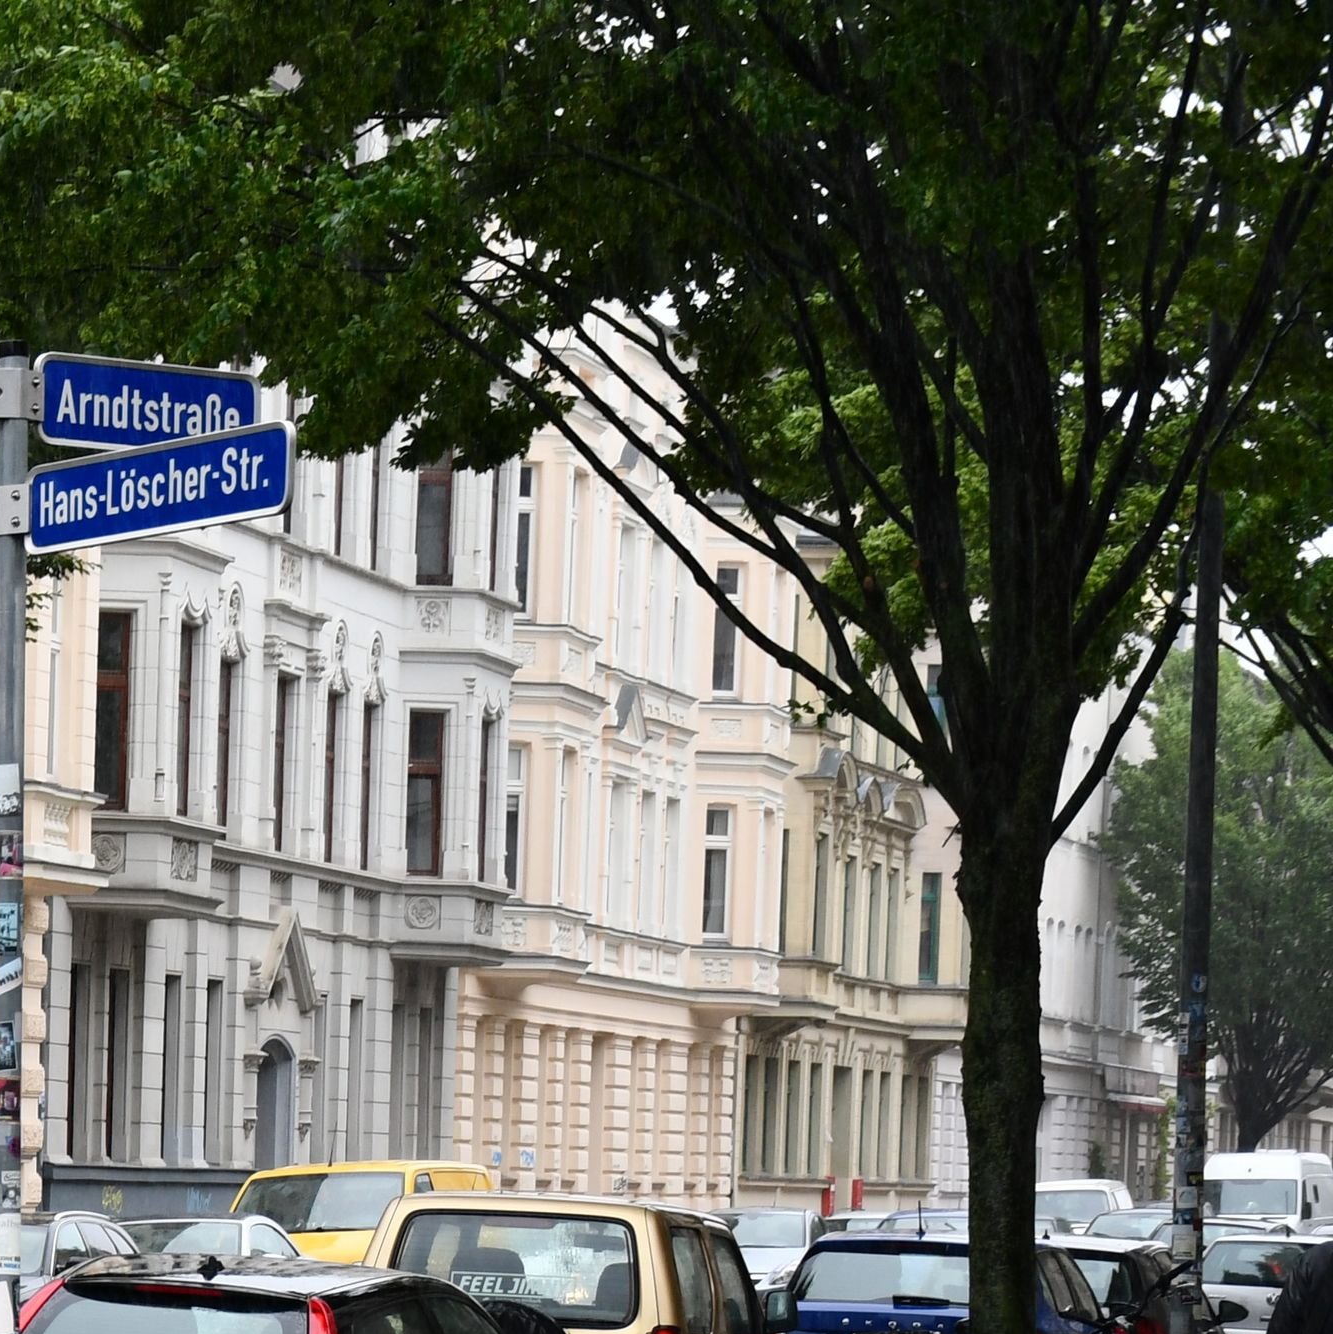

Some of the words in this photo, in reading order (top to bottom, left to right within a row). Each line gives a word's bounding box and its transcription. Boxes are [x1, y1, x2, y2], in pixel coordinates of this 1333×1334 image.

[56, 378, 241, 437] Arndtstraße
[39, 447, 269, 528] Hans-Löscher-Str.
[459, 1275, 504, 1293] FEEL
